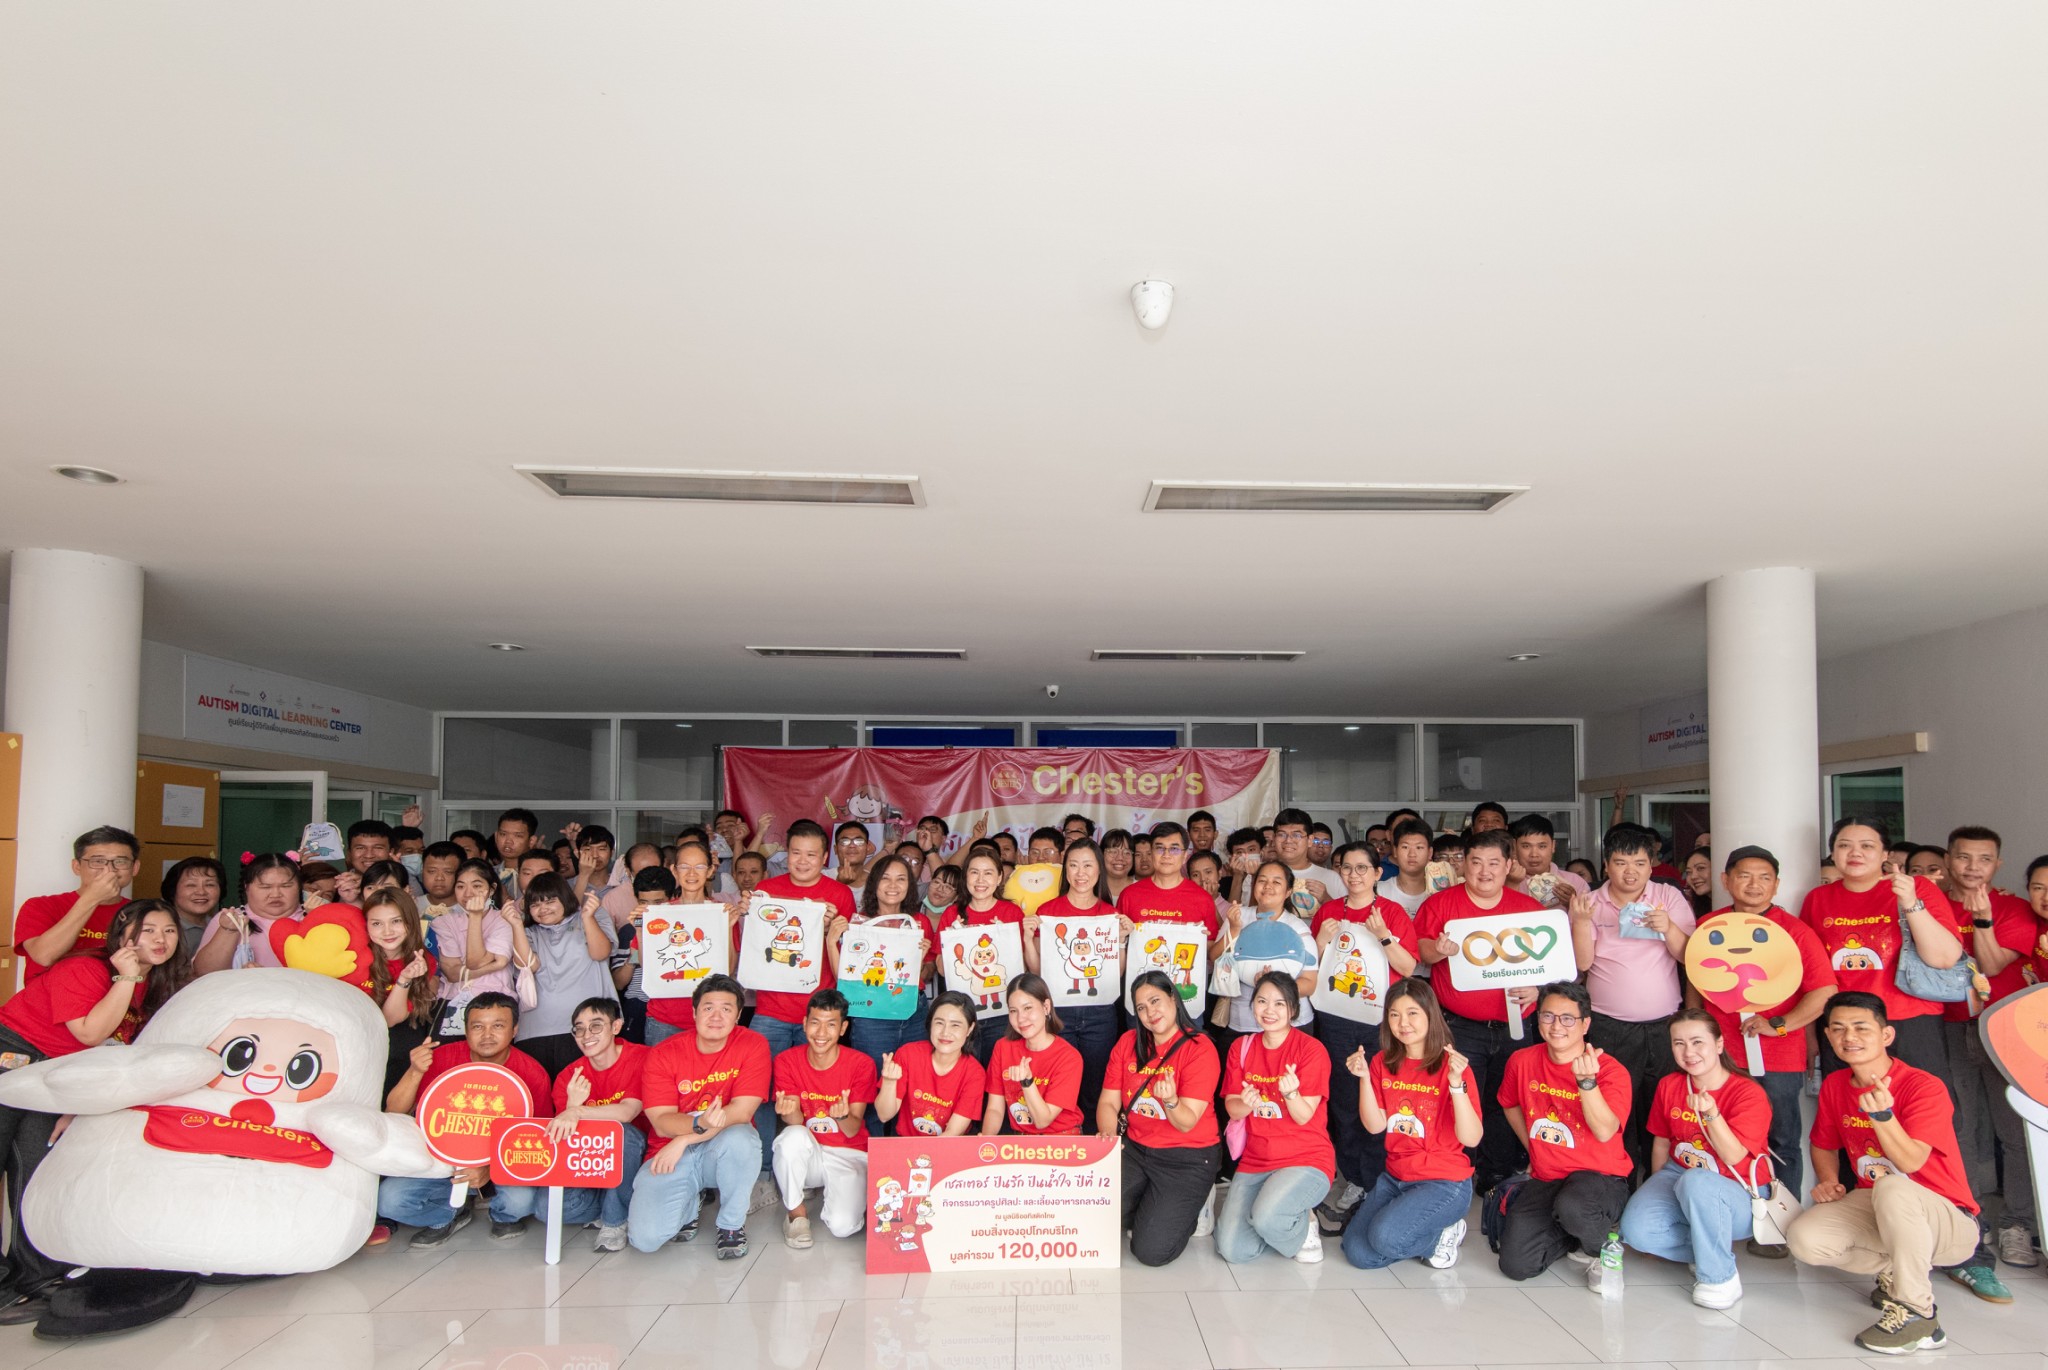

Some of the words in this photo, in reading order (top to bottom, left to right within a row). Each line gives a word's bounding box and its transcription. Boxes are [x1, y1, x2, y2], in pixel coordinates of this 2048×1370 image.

[198, 695, 239, 712] AUTISM
[241, 703, 280, 720] DIGITAL
[281, 711, 328, 729] LEARNING
[330, 720, 362, 735] CENTER
[1648, 730, 1675, 743] AUTISM
[1676, 724, 1707, 738] DIGITAL
[1031, 765, 1205, 795] Chester's
[1149, 909, 1183, 917] Chester's
[1834, 914, 1891, 926] Chester's
[1094, 926, 1112, 937] Good
[1095, 943, 1113, 953] Good
[1481, 965, 1546, 979] ร้อยเรียงความดี
[1392, 1080, 1440, 1096] Chester's
[1539, 1083, 1582, 1102] Cester'
[429, 1107, 514, 1138] CHESTE'
[567, 1131, 615, 1149] Good
[504, 1148, 551, 1167] CHESTER'S
[1000, 1144, 1087, 1160] Chester's
[567, 1153, 615, 1171] Good
[944, 1176, 989, 1189] เชสเตอร์
[994, 1174, 1025, 1189] ปันรัก
[1028, 1168, 1072, 1188] ปันน้ำใจ
[1076, 1170, 1094, 1188] ปีที่
[1098, 1177, 1111, 1188] 12
[942, 1197, 1022, 1211] กิจกรรมวาดรูปศิลปะ
[1023, 1195, 1111, 1207] และเลี้ยงอาหารกลางวัน
[971, 1224, 1078, 1239] มอบสิ่งของอุปโภคบริโภค
[950, 1249, 995, 1264] มูลค่ารวม
[998, 1242, 1078, 1262] 120,000
[1080, 1249, 1099, 1259] บาท
